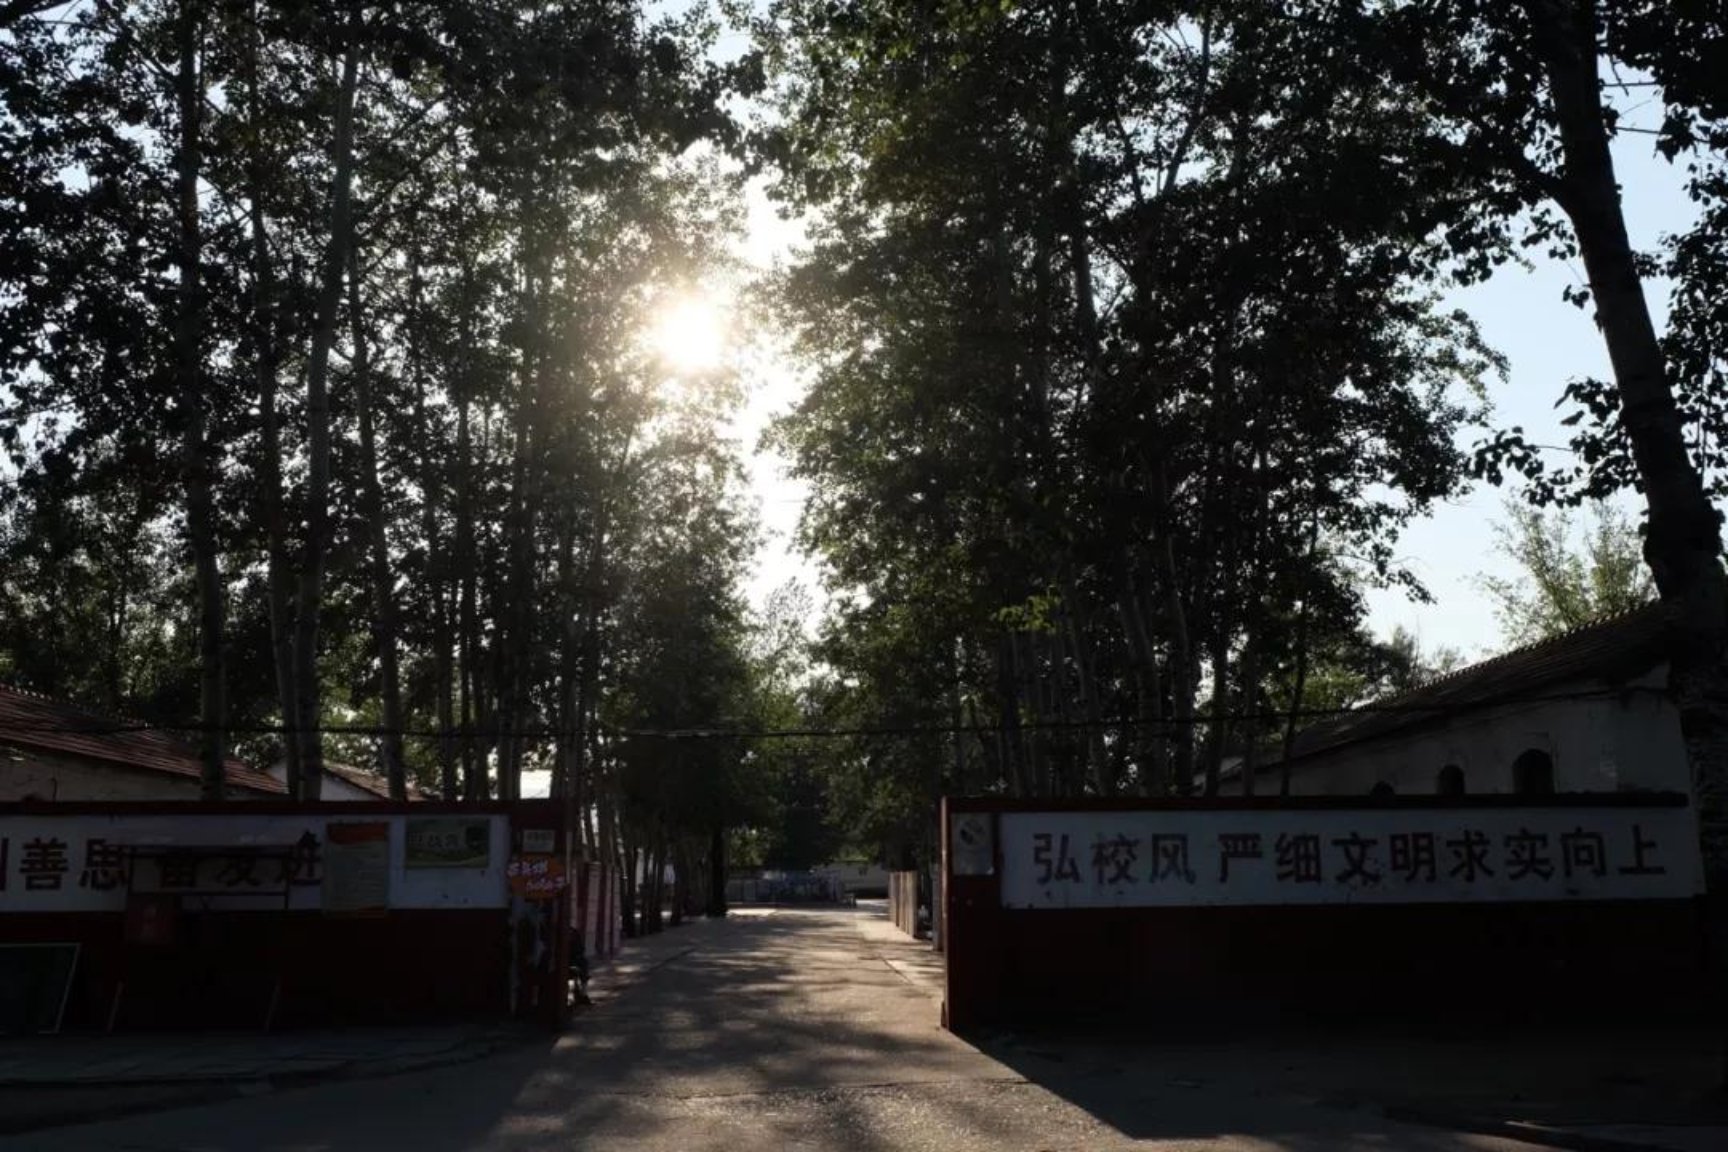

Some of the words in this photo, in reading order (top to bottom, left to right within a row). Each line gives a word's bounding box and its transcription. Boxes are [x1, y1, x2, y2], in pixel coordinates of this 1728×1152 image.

[0, 832, 321, 890] 善思奋发进
